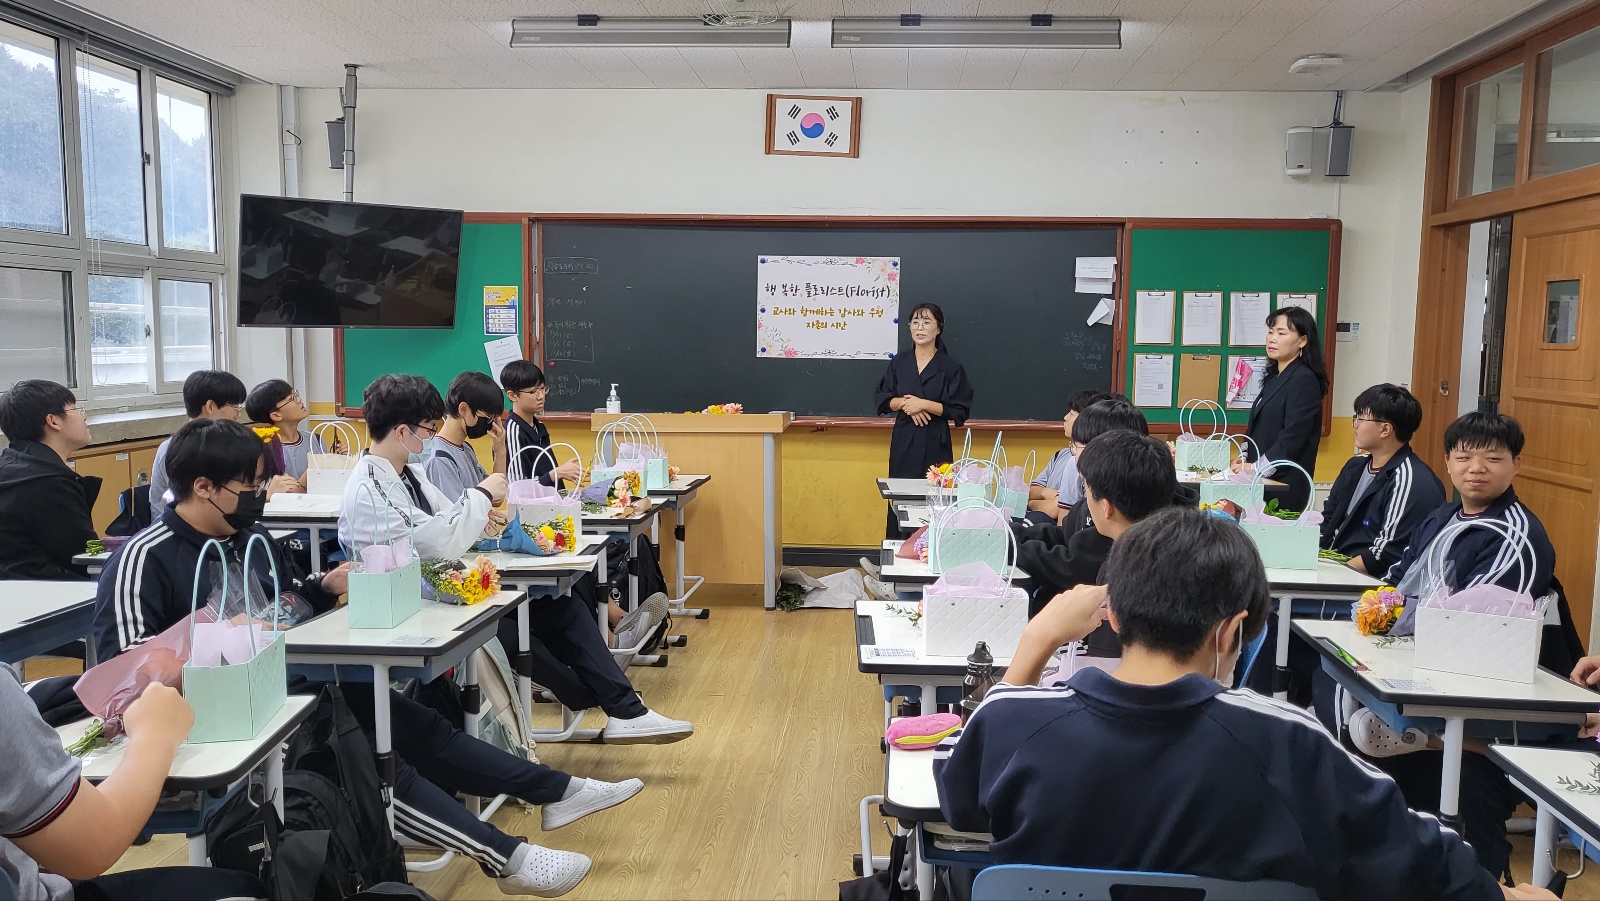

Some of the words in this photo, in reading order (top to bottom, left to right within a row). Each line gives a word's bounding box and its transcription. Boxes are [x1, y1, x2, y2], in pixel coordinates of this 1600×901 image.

[805, 282, 890, 299] 플로리스트(Florist)
[773, 306, 797, 316] 교사와
[800, 305, 835, 318] 함께하는
[838, 307, 866, 318] 감사와
[868, 307, 884, 318] 우정
[806, 320, 828, 330] 자존의
[830, 320, 848, 331] 시간
